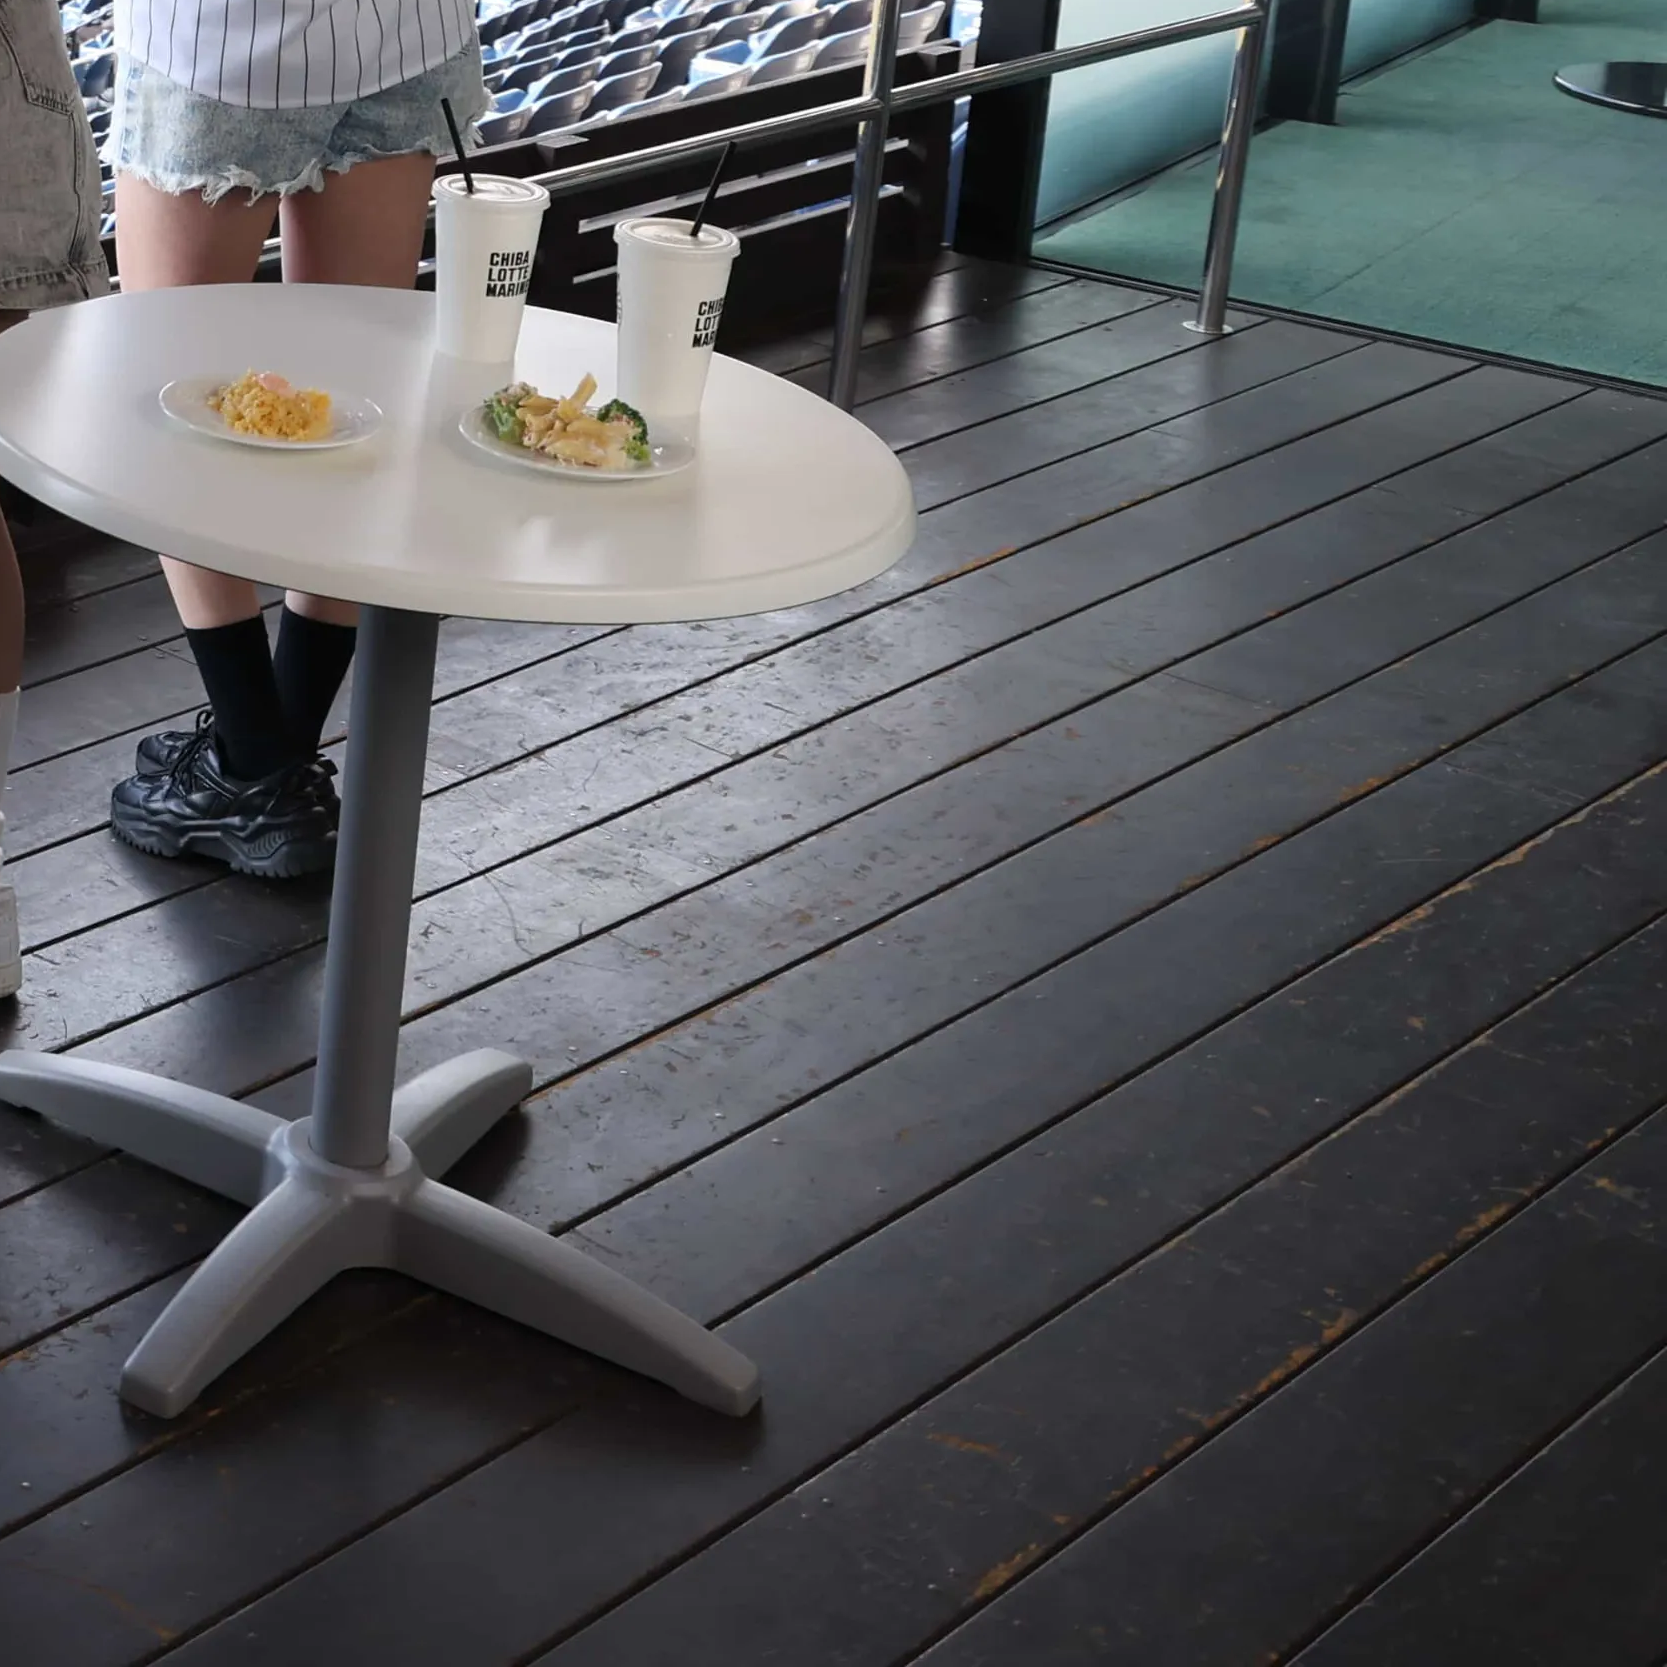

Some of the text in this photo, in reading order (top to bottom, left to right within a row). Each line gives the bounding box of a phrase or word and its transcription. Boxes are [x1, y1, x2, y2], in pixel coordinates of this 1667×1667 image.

[489, 250, 529, 267] CHIBA
[488, 265, 529, 282] LOTTE
[486, 280, 529, 297] MARIN
[698, 298, 724, 316] CHIB
[695, 315, 719, 332] LOT
